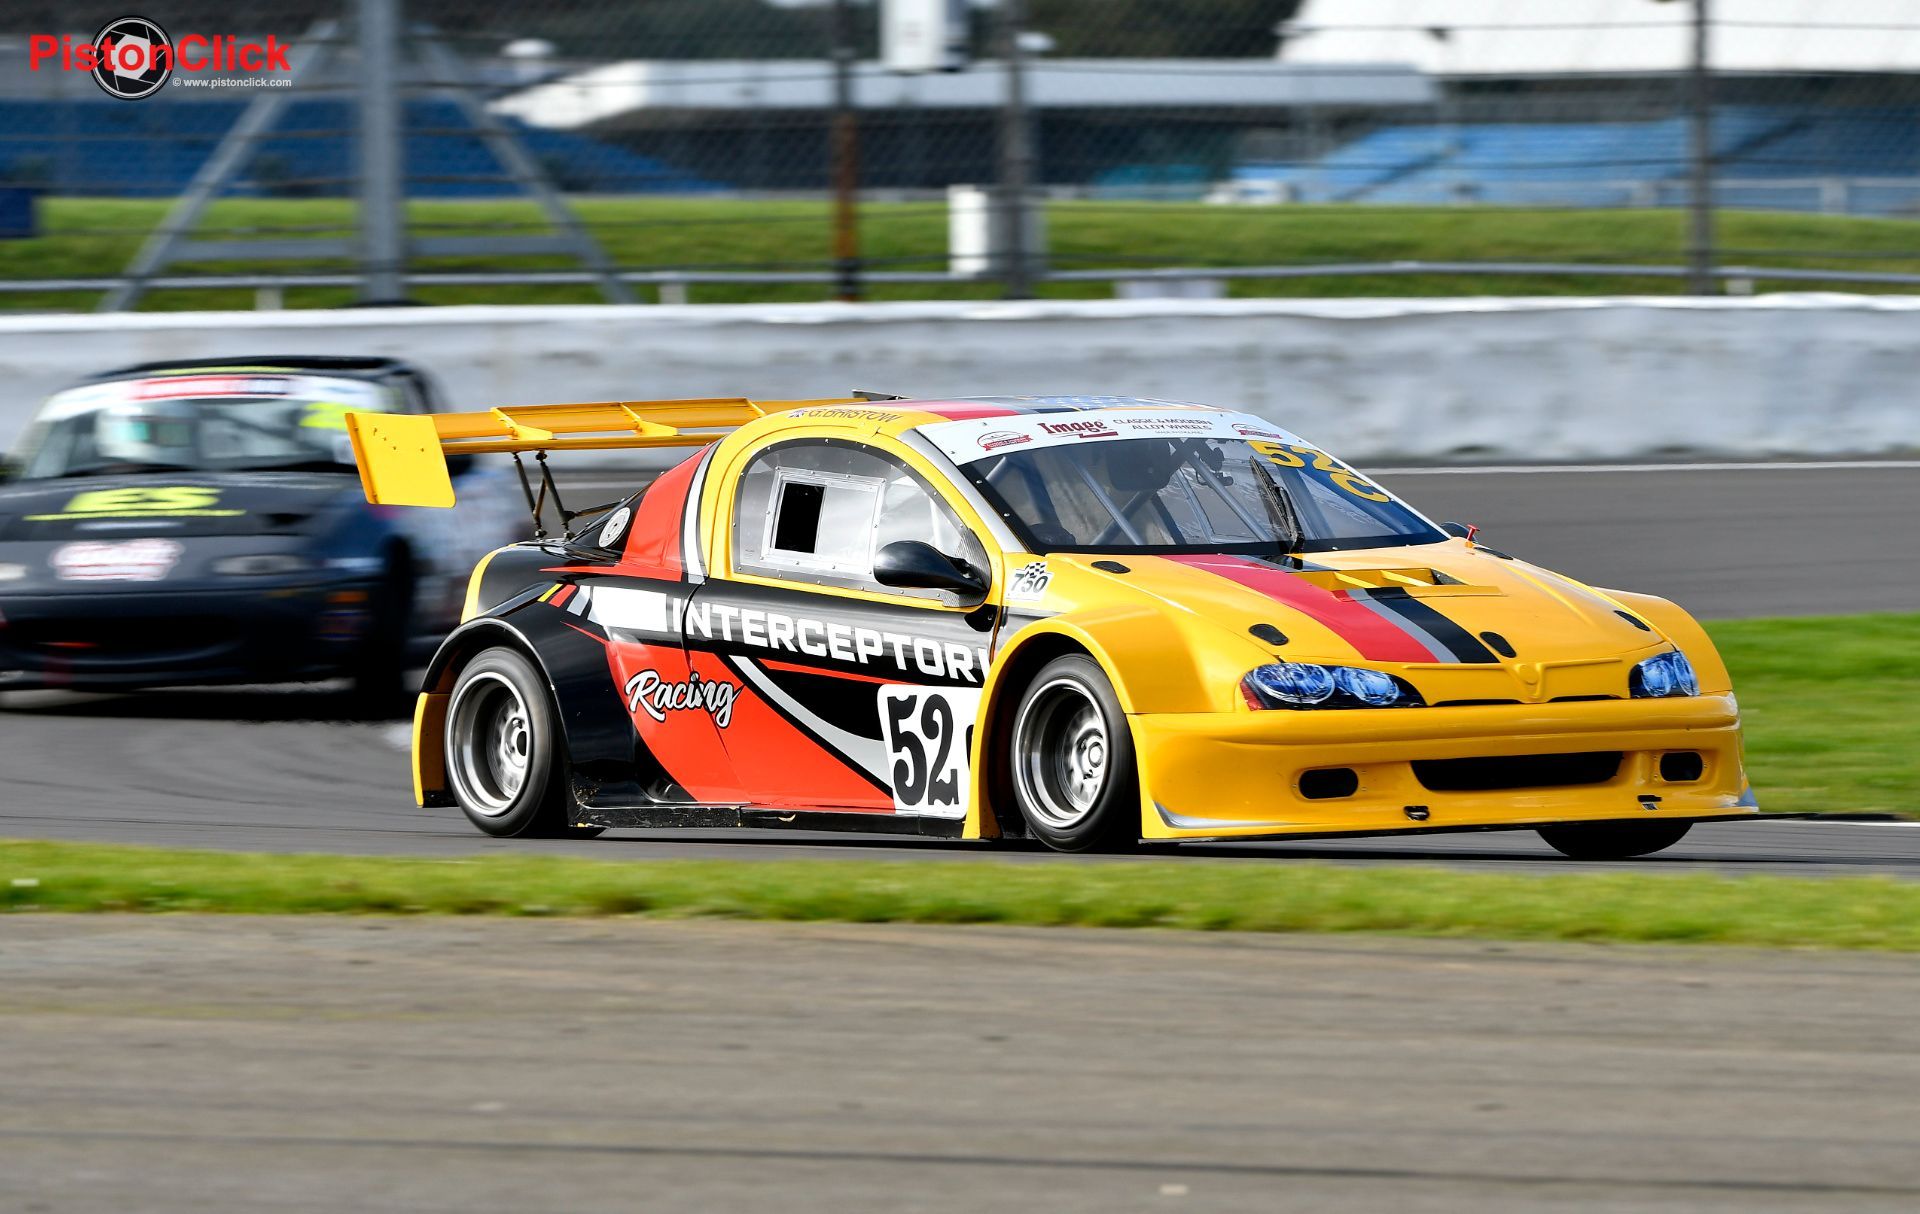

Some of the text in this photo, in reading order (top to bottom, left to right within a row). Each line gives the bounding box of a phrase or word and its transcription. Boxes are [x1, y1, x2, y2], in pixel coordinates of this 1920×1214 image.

[1037, 420, 1107, 434] Image
[1248, 440, 1353, 476] 52
[1330, 473, 1390, 502] C
[1011, 572, 1049, 593] 750
[672, 598, 978, 683] INTERCEPTOR
[625, 671, 745, 728] Racing
[887, 694, 973, 806] 52
